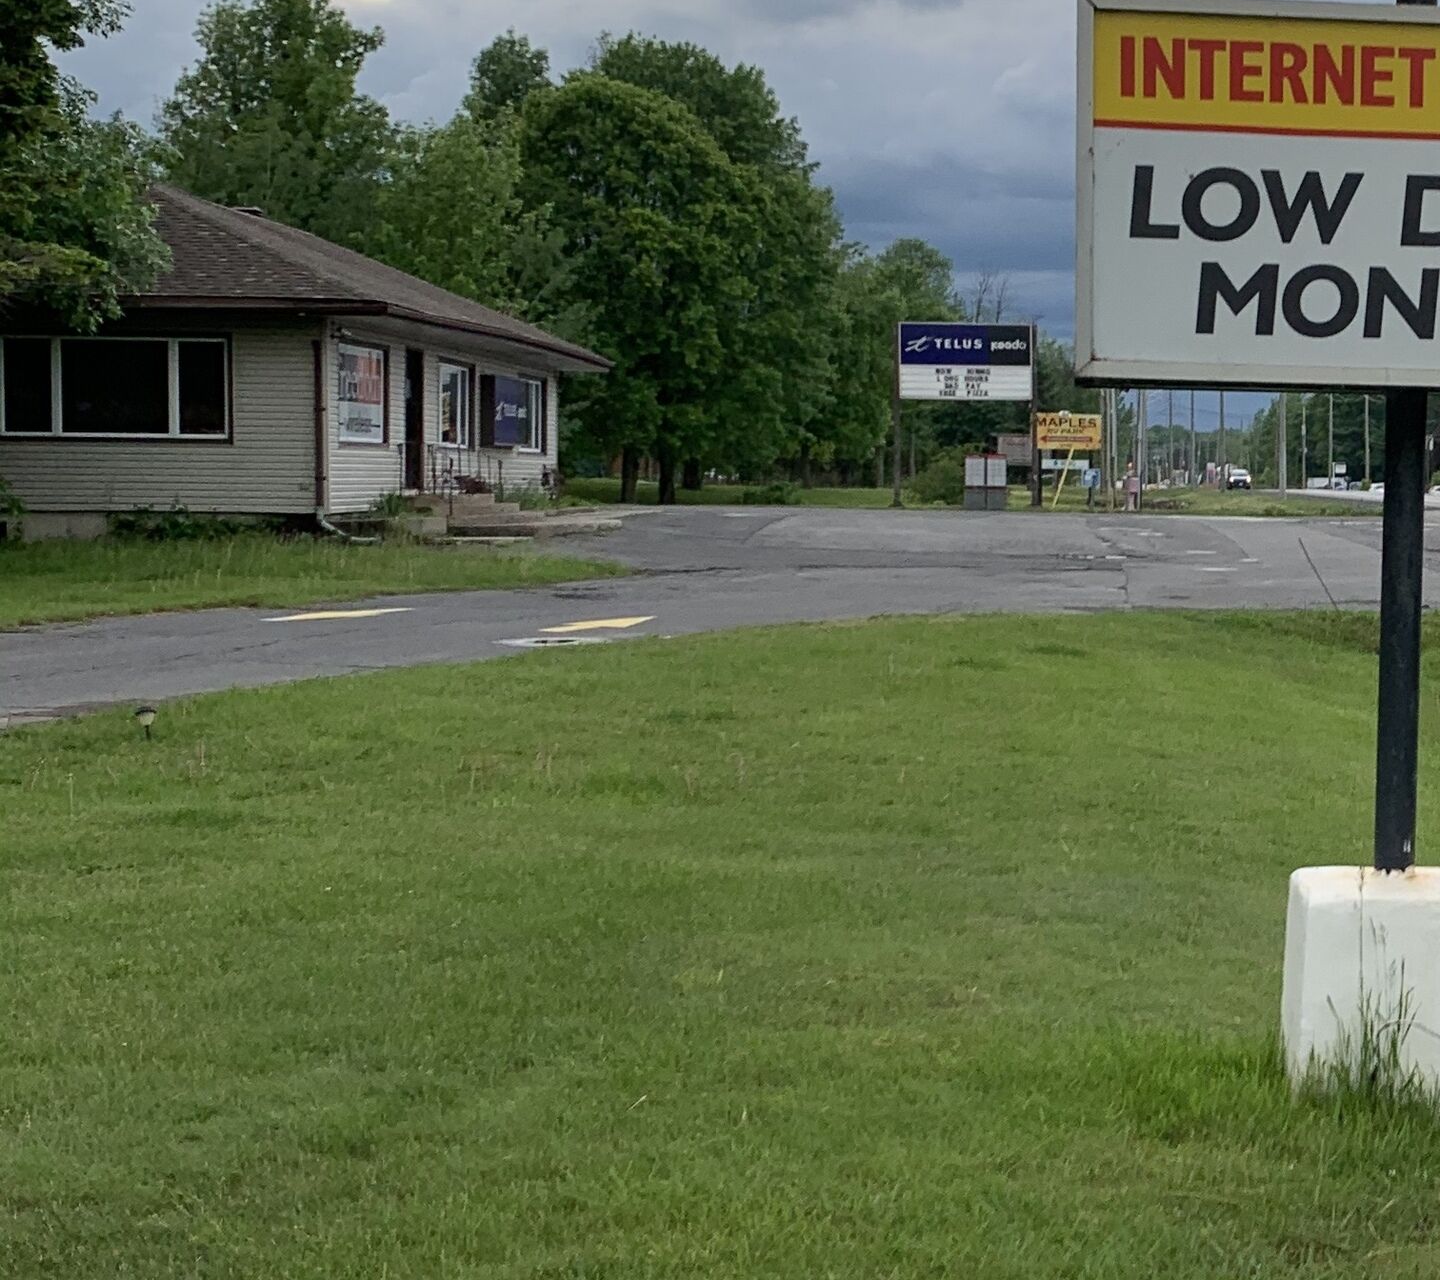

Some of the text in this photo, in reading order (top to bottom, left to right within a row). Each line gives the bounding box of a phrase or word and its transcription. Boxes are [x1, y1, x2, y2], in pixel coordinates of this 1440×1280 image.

[1119, 36, 1435, 109] INTERNET
[1129, 164, 1365, 246] LOW
[933, 338, 983, 350] TELUS
[1036, 417, 1097, 428] MAPLES
